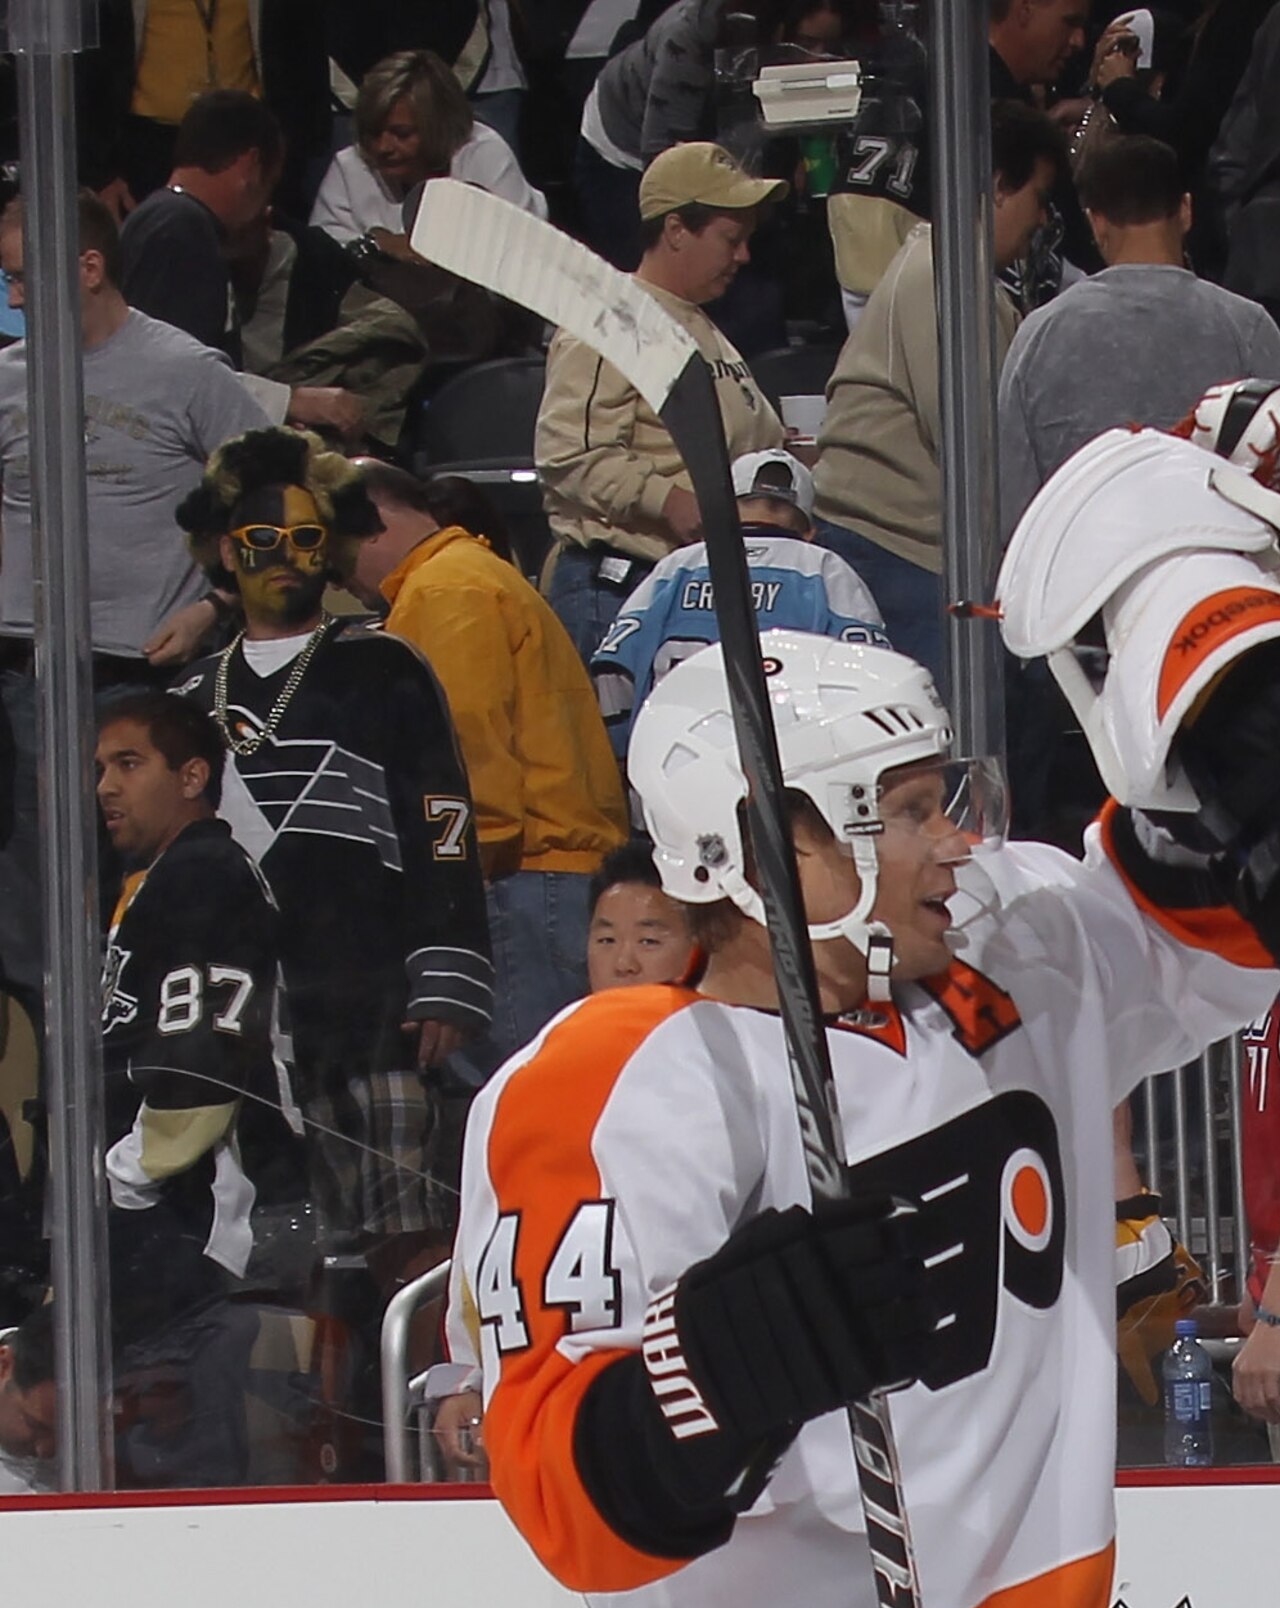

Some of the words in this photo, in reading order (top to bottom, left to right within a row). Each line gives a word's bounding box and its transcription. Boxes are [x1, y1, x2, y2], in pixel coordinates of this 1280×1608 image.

[848, 136, 918, 198] 71
[682, 580, 782, 612] CRBY
[424, 795, 468, 860] 7
[157, 962, 254, 1036] 87
[477, 1198, 622, 1358] 44
